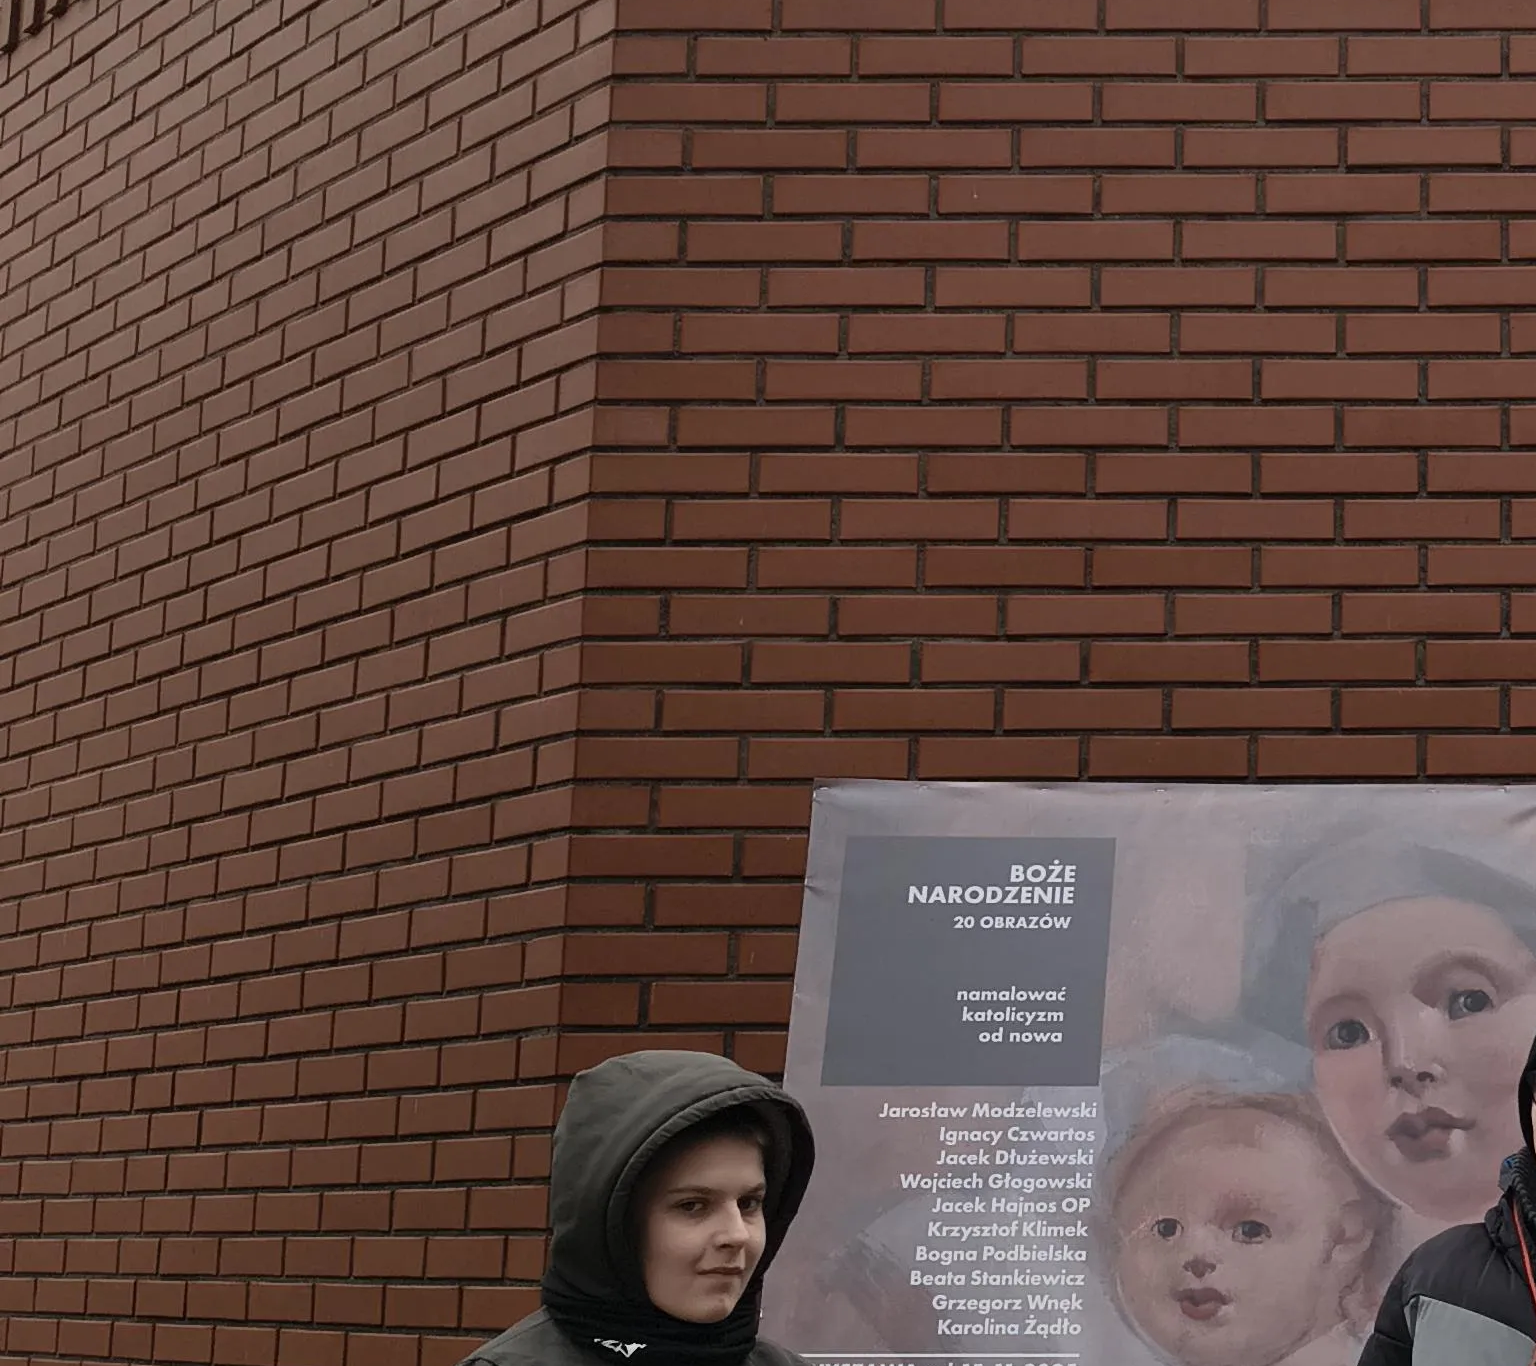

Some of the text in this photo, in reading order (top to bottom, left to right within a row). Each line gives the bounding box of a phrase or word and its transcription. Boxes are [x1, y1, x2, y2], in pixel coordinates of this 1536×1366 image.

[1011, 860, 1076, 882] BOŻE
[908, 886, 1074, 903] NARODZENIE
[954, 913, 1071, 928] 20 OBRAZÓW
[957, 986, 1066, 1001] namalować
[962, 1007, 1063, 1025] katolicyzm
[979, 1027, 1062, 1042] od nowa
[879, 1102, 1098, 1118] Jarosław Modzelewski
[940, 1127, 1096, 1145] Ignacy Czwartos
[937, 1149, 1093, 1165] Jacek Dłużewski
[900, 1173, 1092, 1193] Wojciech Głogowski
[932, 1197, 1090, 1217] Jacek Hajnos OP
[928, 1220, 1088, 1241] Krzysztof Klimek
[916, 1245, 1088, 1265] Bogna Podbielska
[911, 1269, 1084, 1287] Beata Stankiewicz
[932, 1293, 1082, 1314] Grzegorz Wnęk
[936, 1315, 1081, 1339] Karolina Żądło
